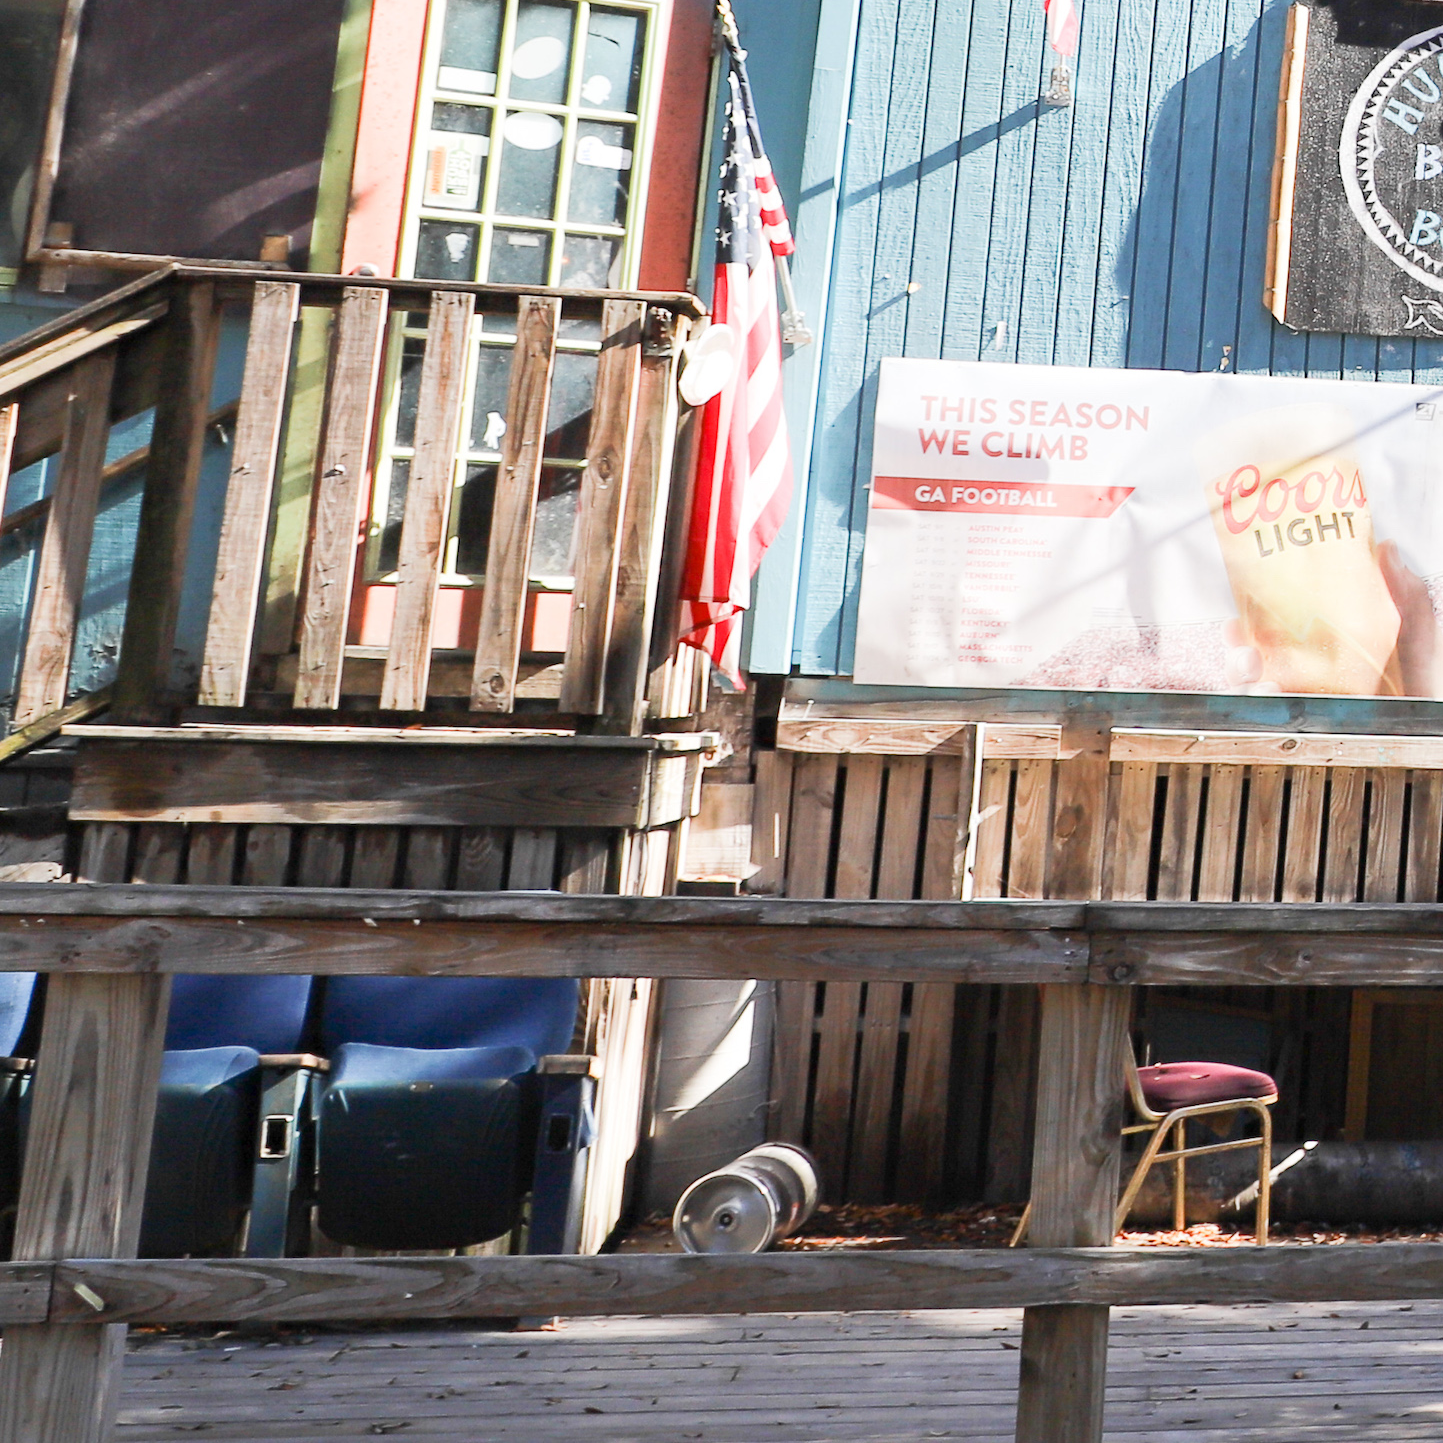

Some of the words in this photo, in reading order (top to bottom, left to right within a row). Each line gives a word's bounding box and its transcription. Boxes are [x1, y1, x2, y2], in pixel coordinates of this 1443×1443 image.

[919, 394, 999, 425] THIS
[1007, 398, 1151, 432] SEASON
[917, 427, 972, 457] WE
[980, 430, 1089, 462] CLIMB
[914, 485, 946, 504] GA
[951, 486, 1058, 508] FOOTBALL
[1214, 463, 1368, 535] Coors
[967, 536, 998, 544] SOUTH
[1253, 511, 1356, 559] LIGHT
[967, 548, 1000, 556] MIDDLE
[1003, 549, 1053, 558] TENNESSEE
[957, 655, 998, 663] GEORGIA
